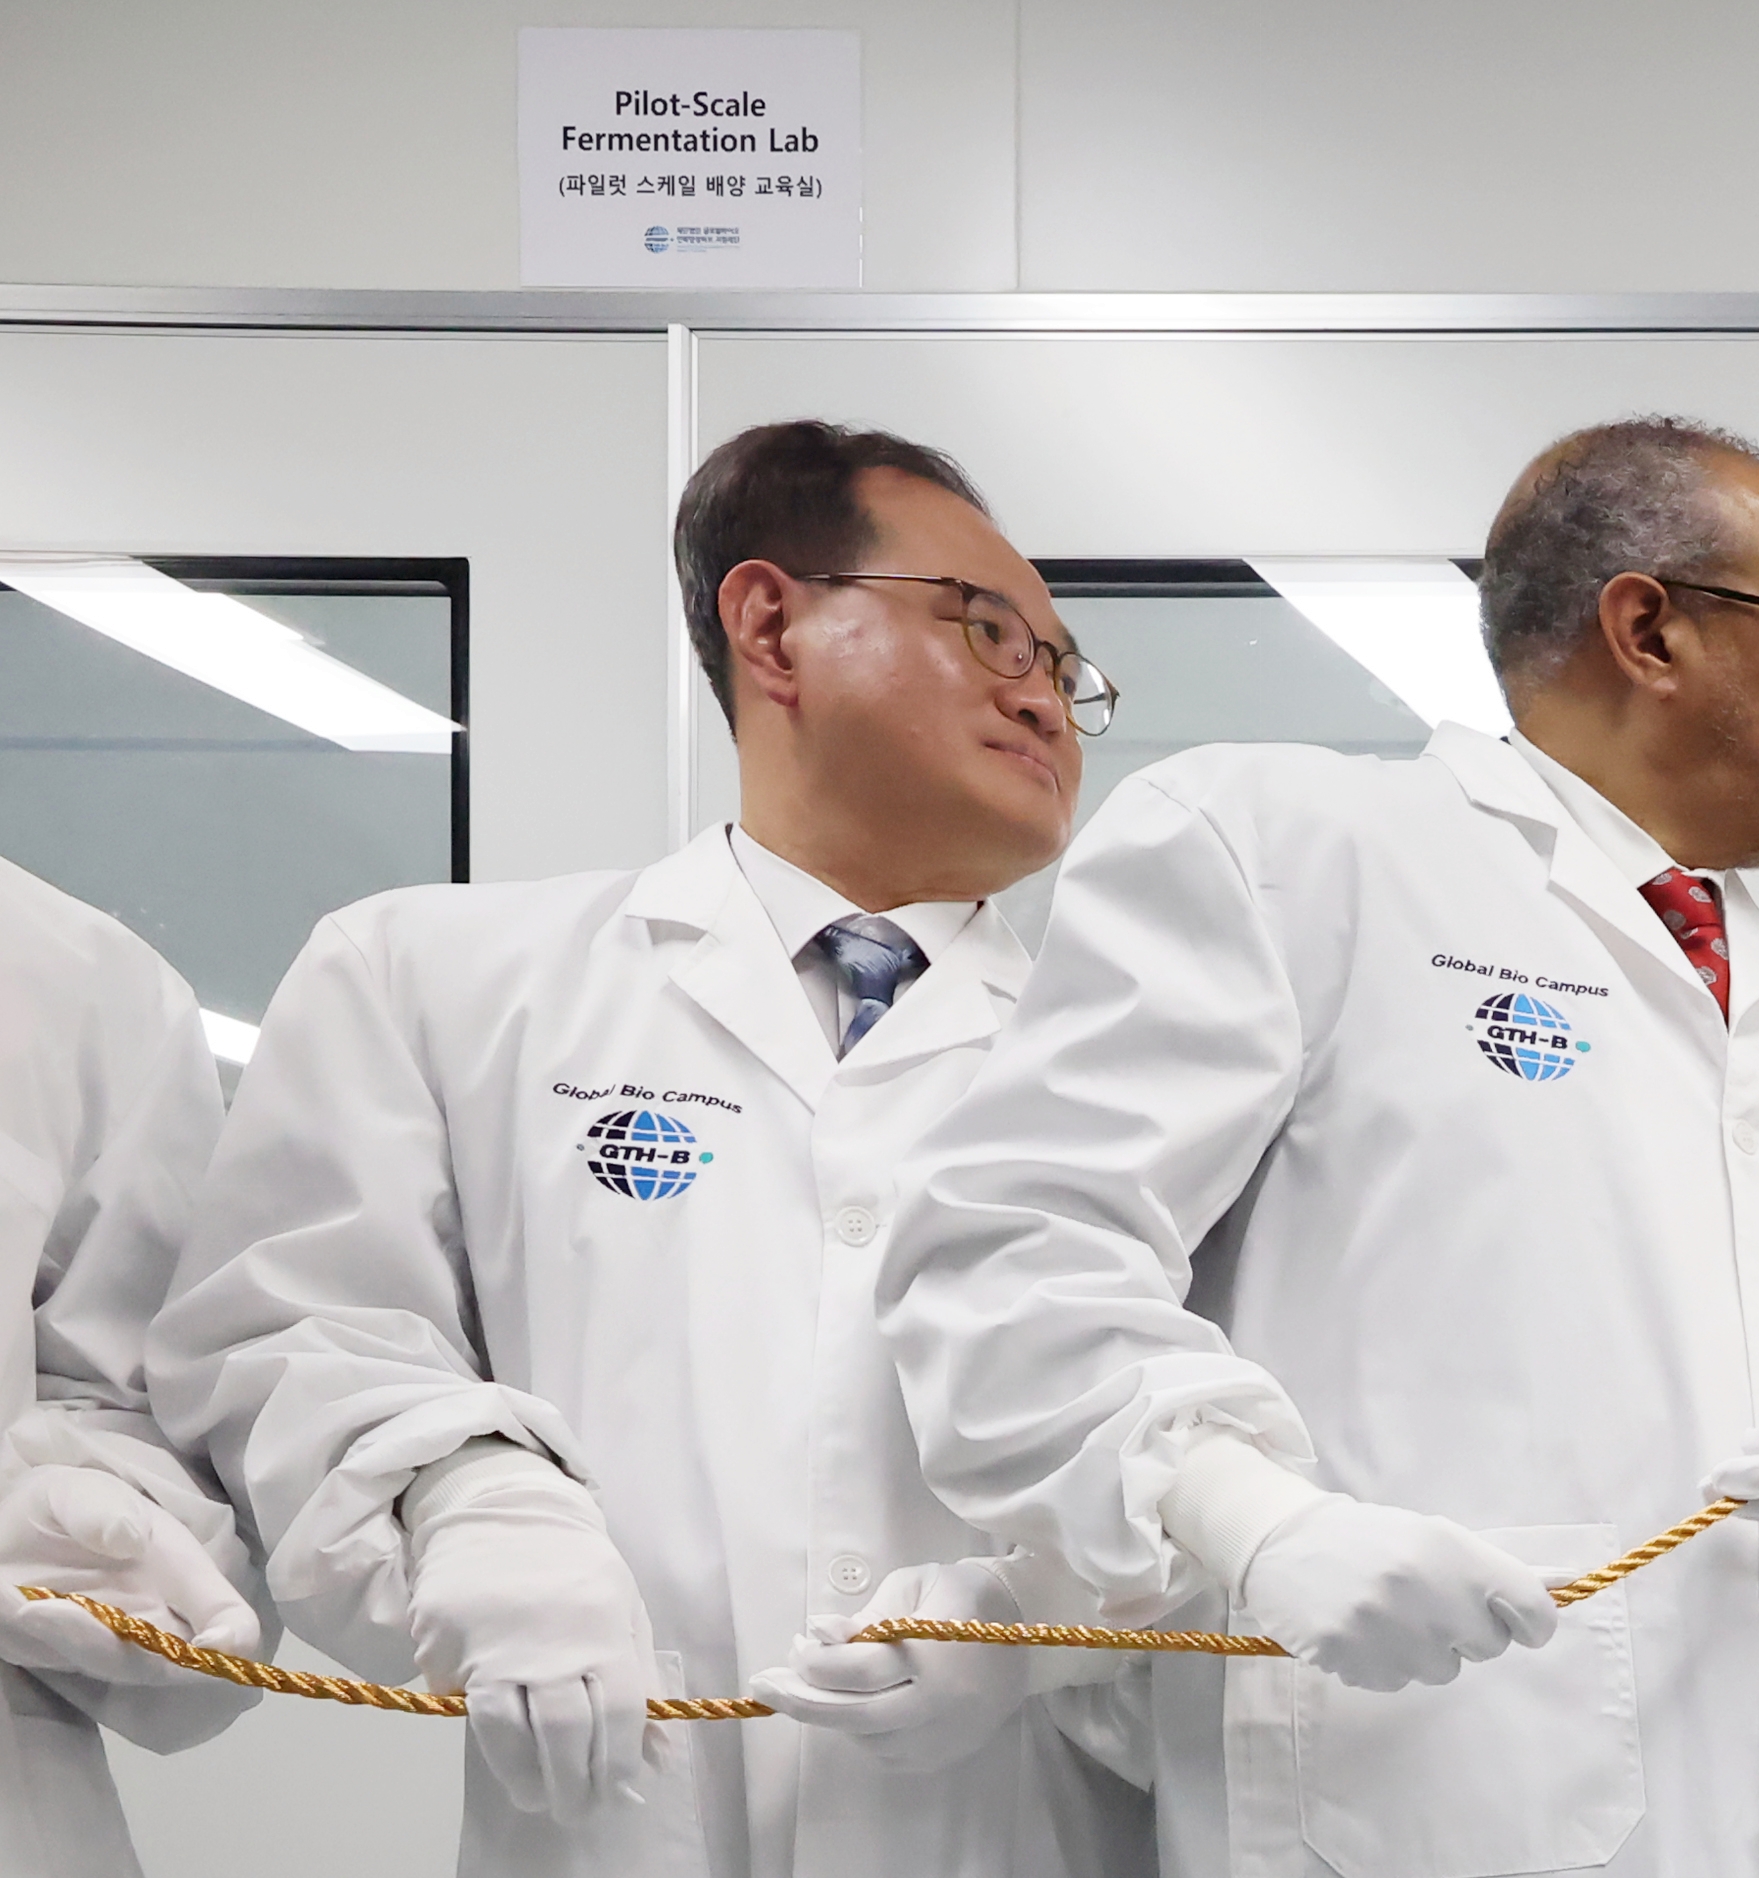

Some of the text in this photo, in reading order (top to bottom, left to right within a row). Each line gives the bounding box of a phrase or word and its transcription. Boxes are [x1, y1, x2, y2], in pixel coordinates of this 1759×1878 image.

[615, 90, 766, 117] Pilot-Scale
[562, 126, 819, 153] Fermentation Lab
[559, 174, 822, 199] (파일럿 스케일 배양 교육실)
[1431, 954, 1609, 997] Global Bio Campus
[1487, 1024, 1568, 1049] GTH-B
[552, 1082, 743, 1114] Global Bio Campus
[599, 1143, 690, 1164] GTH-B
